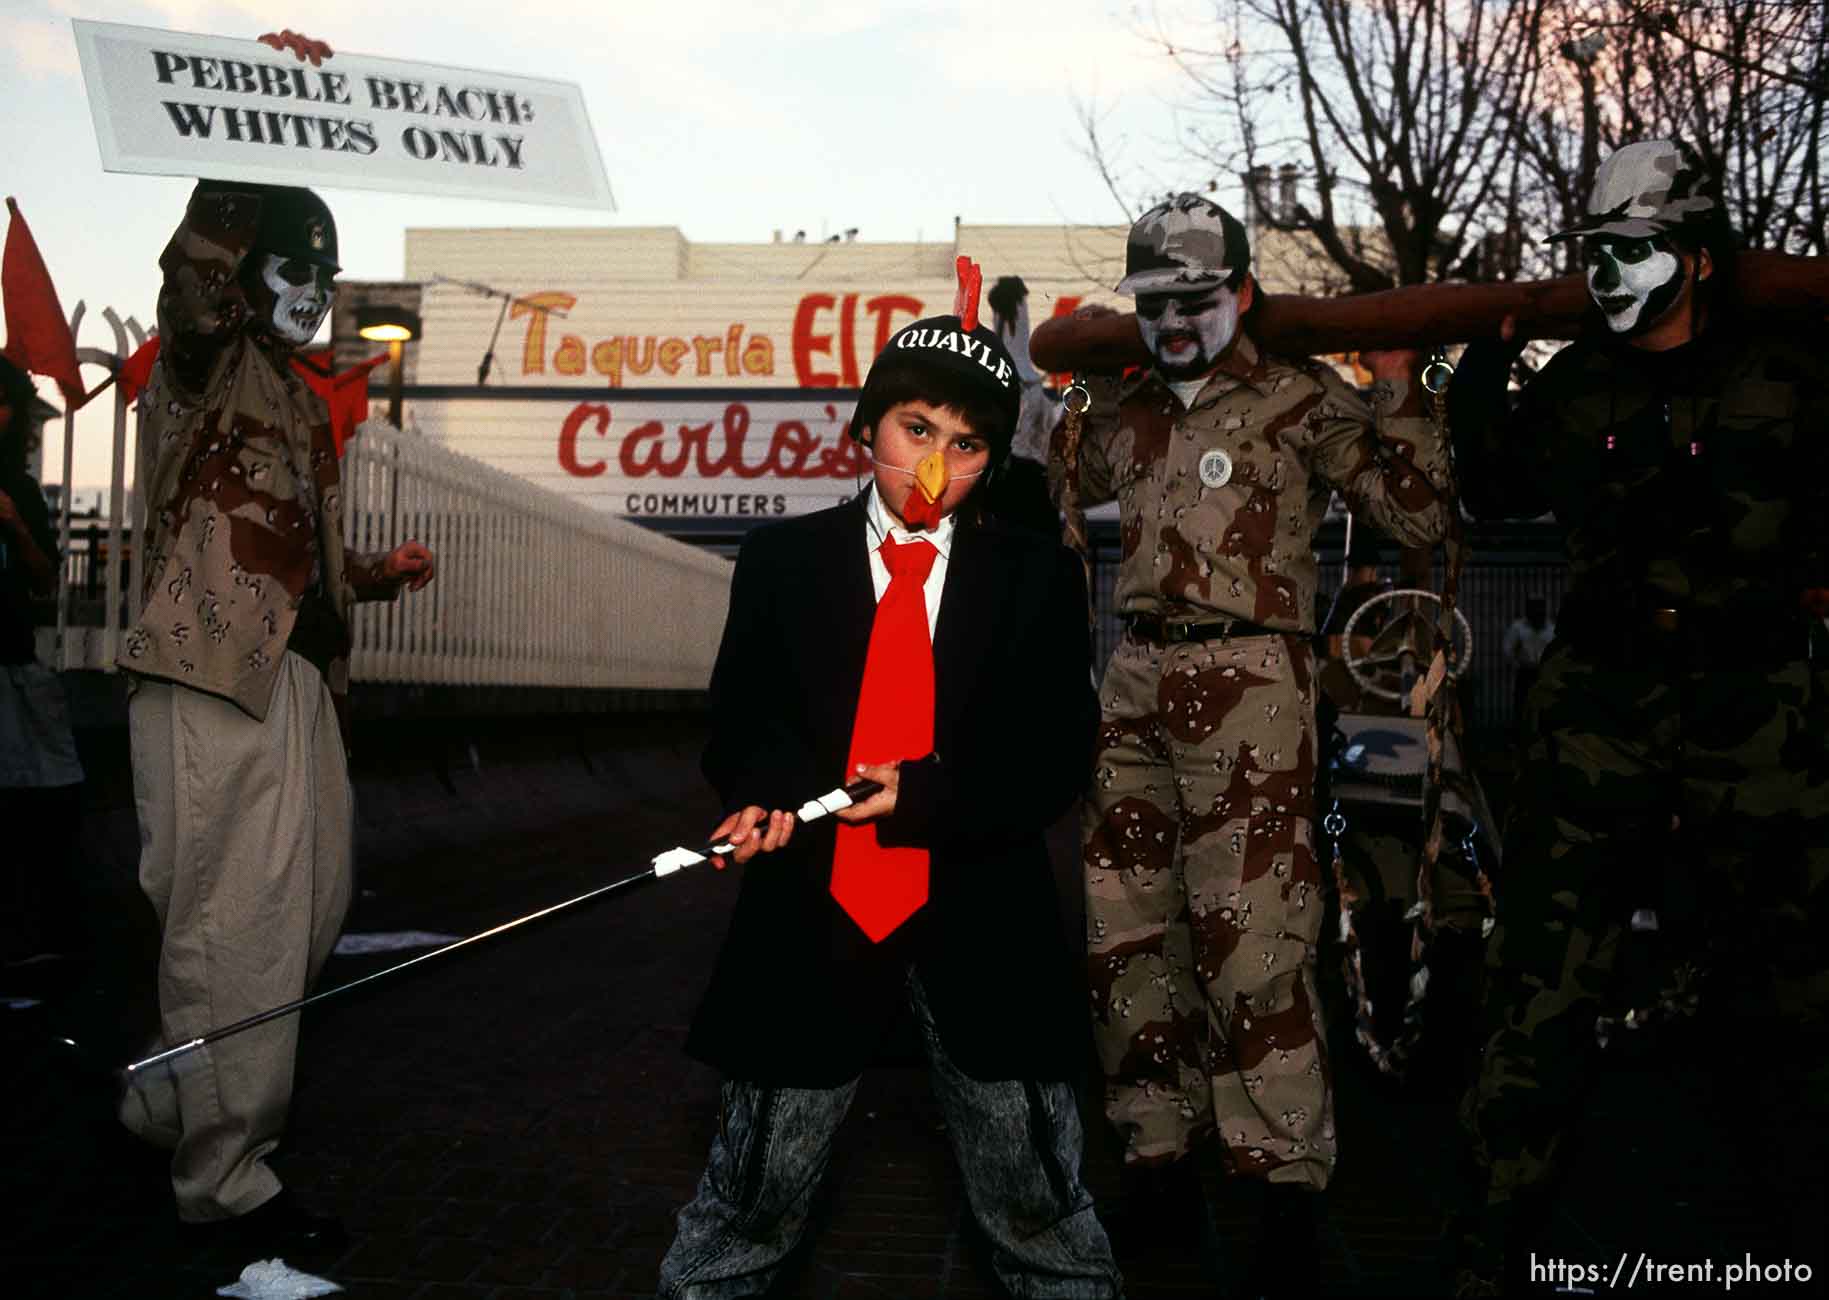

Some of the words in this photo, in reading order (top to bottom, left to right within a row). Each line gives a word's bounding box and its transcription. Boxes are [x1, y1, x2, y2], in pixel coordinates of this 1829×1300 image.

[152, 49, 351, 104] PEBBLE
[366, 75, 535, 125] BEACH:
[162, 100, 379, 155] WHITES
[402, 126, 526, 169] ONLY
[896, 328, 1013, 388] QUAYLE
[625, 493, 787, 514] COMMUTERS
